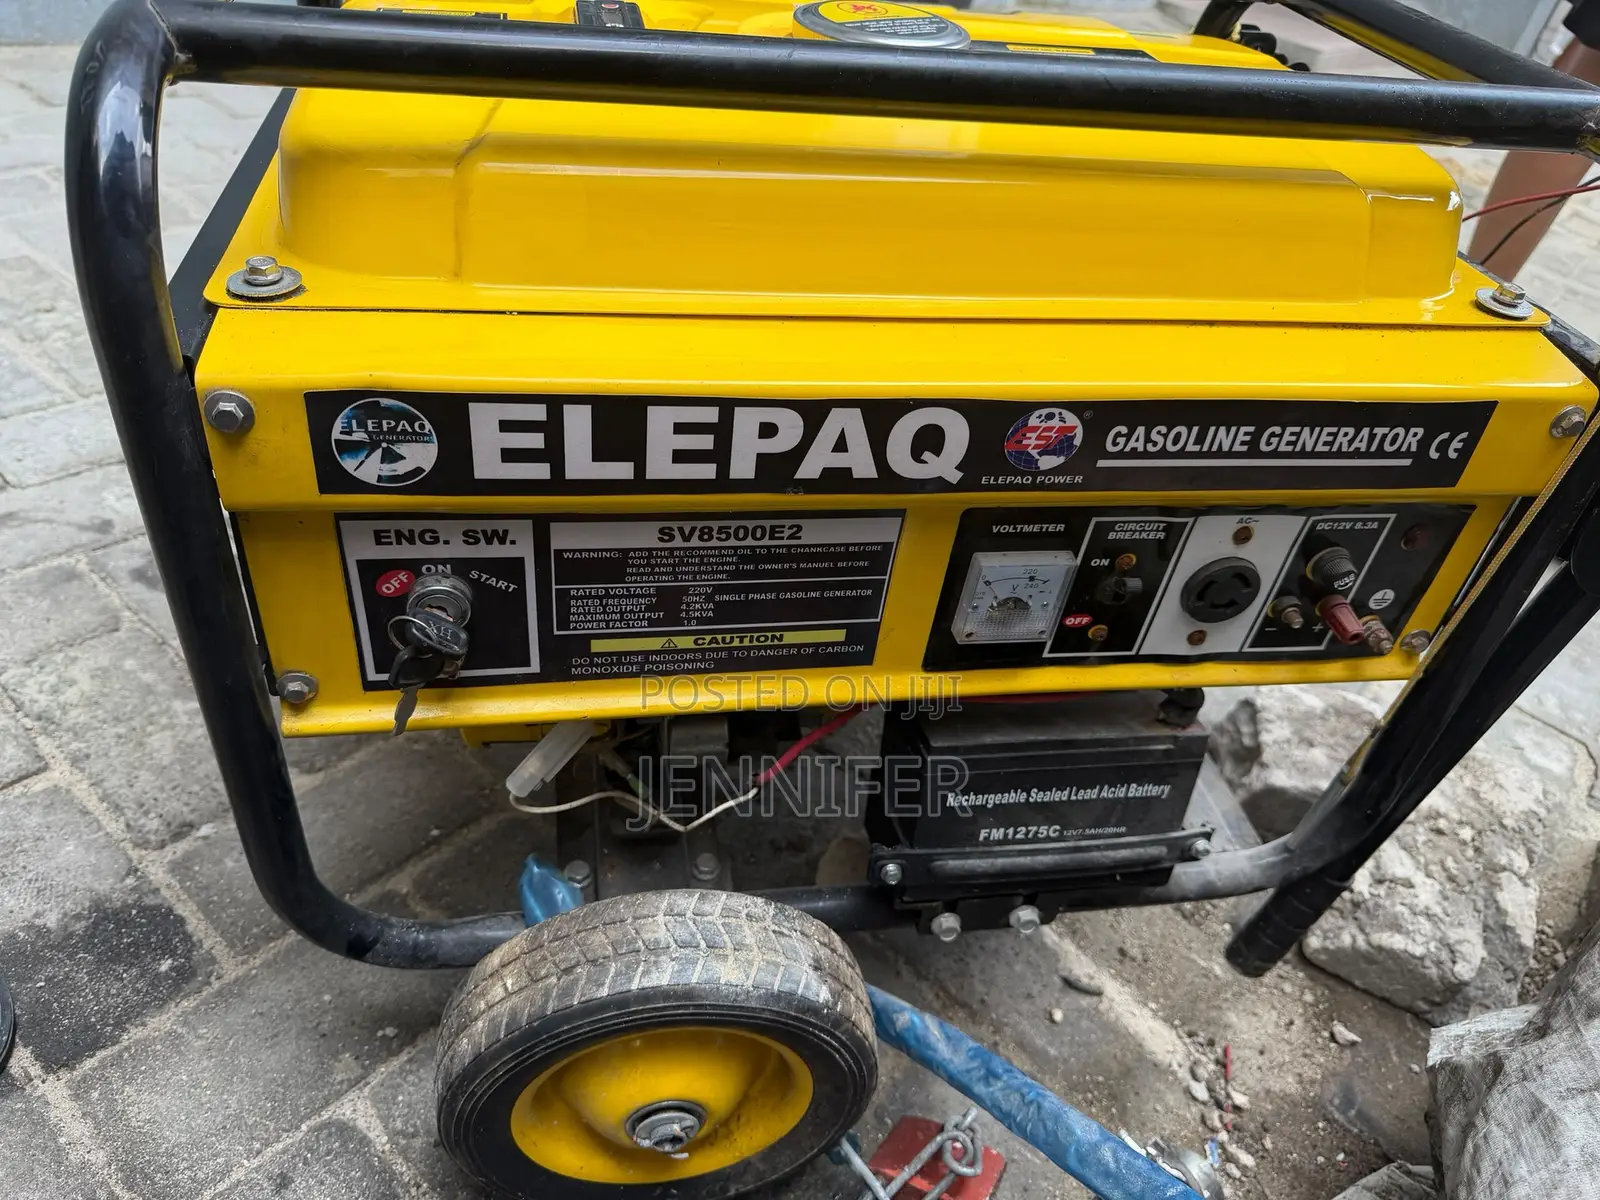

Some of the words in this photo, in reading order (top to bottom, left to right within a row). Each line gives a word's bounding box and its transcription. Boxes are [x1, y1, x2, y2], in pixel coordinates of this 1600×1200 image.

[339, 419, 430, 434] ELEPAQ
[468, 402, 970, 485] ELEPAQ
[1105, 426, 1255, 452] GASOLINE
[1259, 427, 1424, 452] GENERATOR
[981, 476, 1032, 484] ELEPAQ
[1036, 475, 1083, 484] POWER
[992, 524, 1065, 533] VOLTMETER
[1114, 523, 1167, 531] CIRCUIT
[1316, 521, 1352, 530] DC12V
[1354, 521, 1379, 529] 8.3A
[373, 528, 450, 546] ENG.
[462, 528, 517, 546] SW.
[657, 523, 803, 543] SV8500E2
[1108, 532, 1166, 540] BREAKER
[563, 551, 623, 559] WARNING:
[758, 562, 797, 570] OWNER'S
[1090, 558, 1110, 567] ON
[421, 564, 452, 575] ON
[382, 571, 409, 594] OFF
[469, 570, 518, 593] START
[1333, 573, 1356, 588] FUSE
[570, 588, 605, 596] RATED
[608, 587, 657, 595] VOLTAGE
[748, 592, 776, 600] PHASE
[779, 590, 821, 599] GASOLINE
[824, 589, 873, 597] GENERATOR
[603, 597, 657, 605] FREQUENCY
[569, 613, 621, 621] MAXIMUM
[1065, 617, 1090, 625] OFF
[609, 620, 648, 628] FACTOR
[692, 633, 784, 646] CAUTION
[572, 657, 590, 665] DO
[593, 656, 619, 664] NOT
[621, 655, 645, 663] USE
[648, 652, 702, 662] INDOORS
[705, 651, 729, 659] DUE
[732, 650, 748, 658] TO
[750, 647, 797, 657] DANGER
[800, 646, 816, 654] OF
[818, 644, 864, 653] CARBON
[571, 664, 641, 675] MONOXIDE
[644, 661, 715, 671] POISONING
[946, 789, 1026, 808] Rechargeable
[1029, 786, 1069, 803] Sealed
[1070, 784, 1098, 800] Lead
[1099, 783, 1125, 799] Acid
[1127, 783, 1171, 798] Battery
[979, 825, 1061, 842] FM1275C
